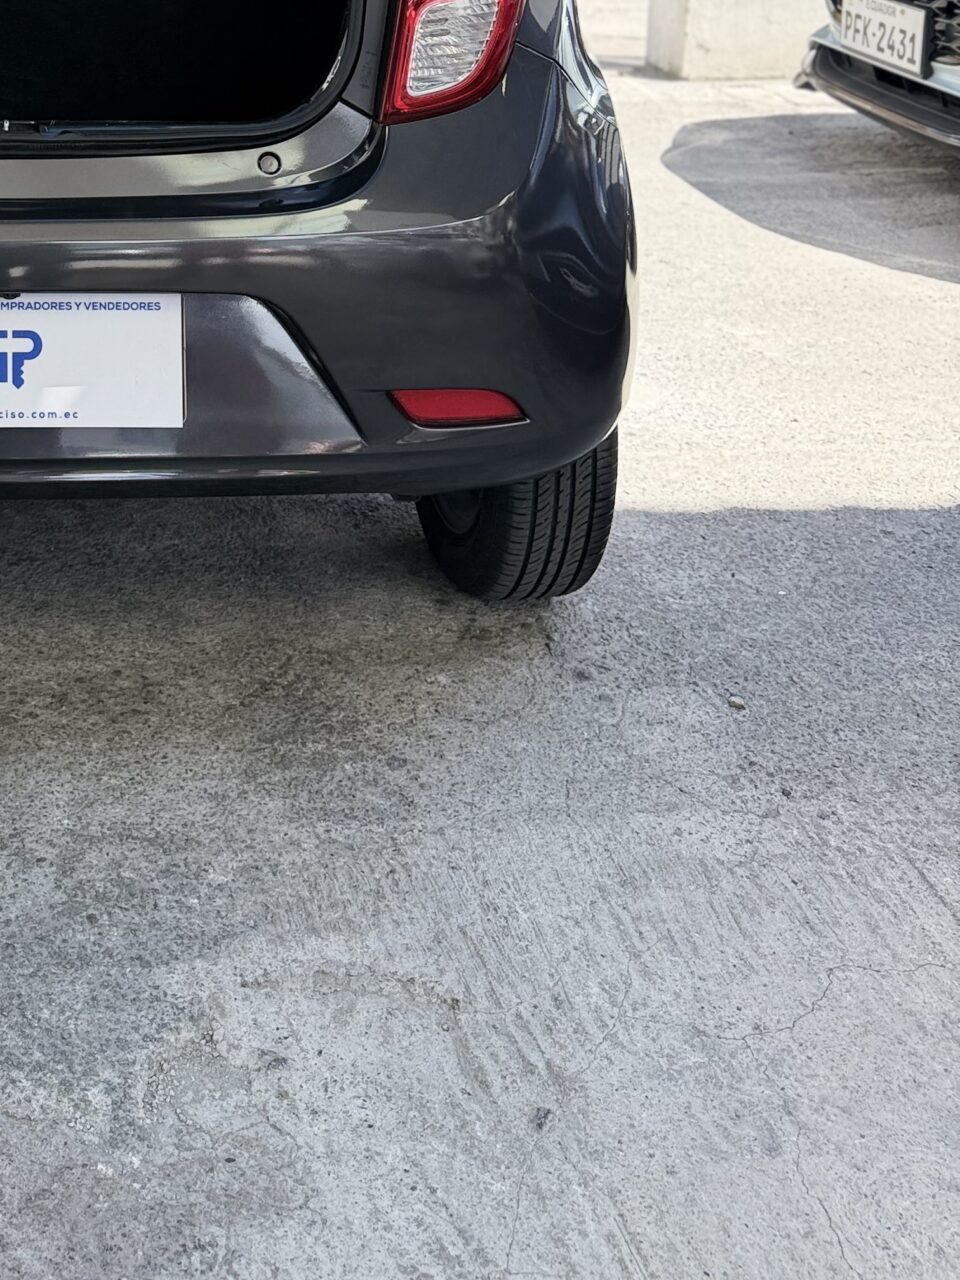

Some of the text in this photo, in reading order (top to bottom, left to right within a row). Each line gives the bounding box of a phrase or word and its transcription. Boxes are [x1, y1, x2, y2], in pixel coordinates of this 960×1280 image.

[844, 9, 917, 65] PFK-2431
[74, 300, 82, 312] Y
[84, 300, 162, 312] VENDEDORES
